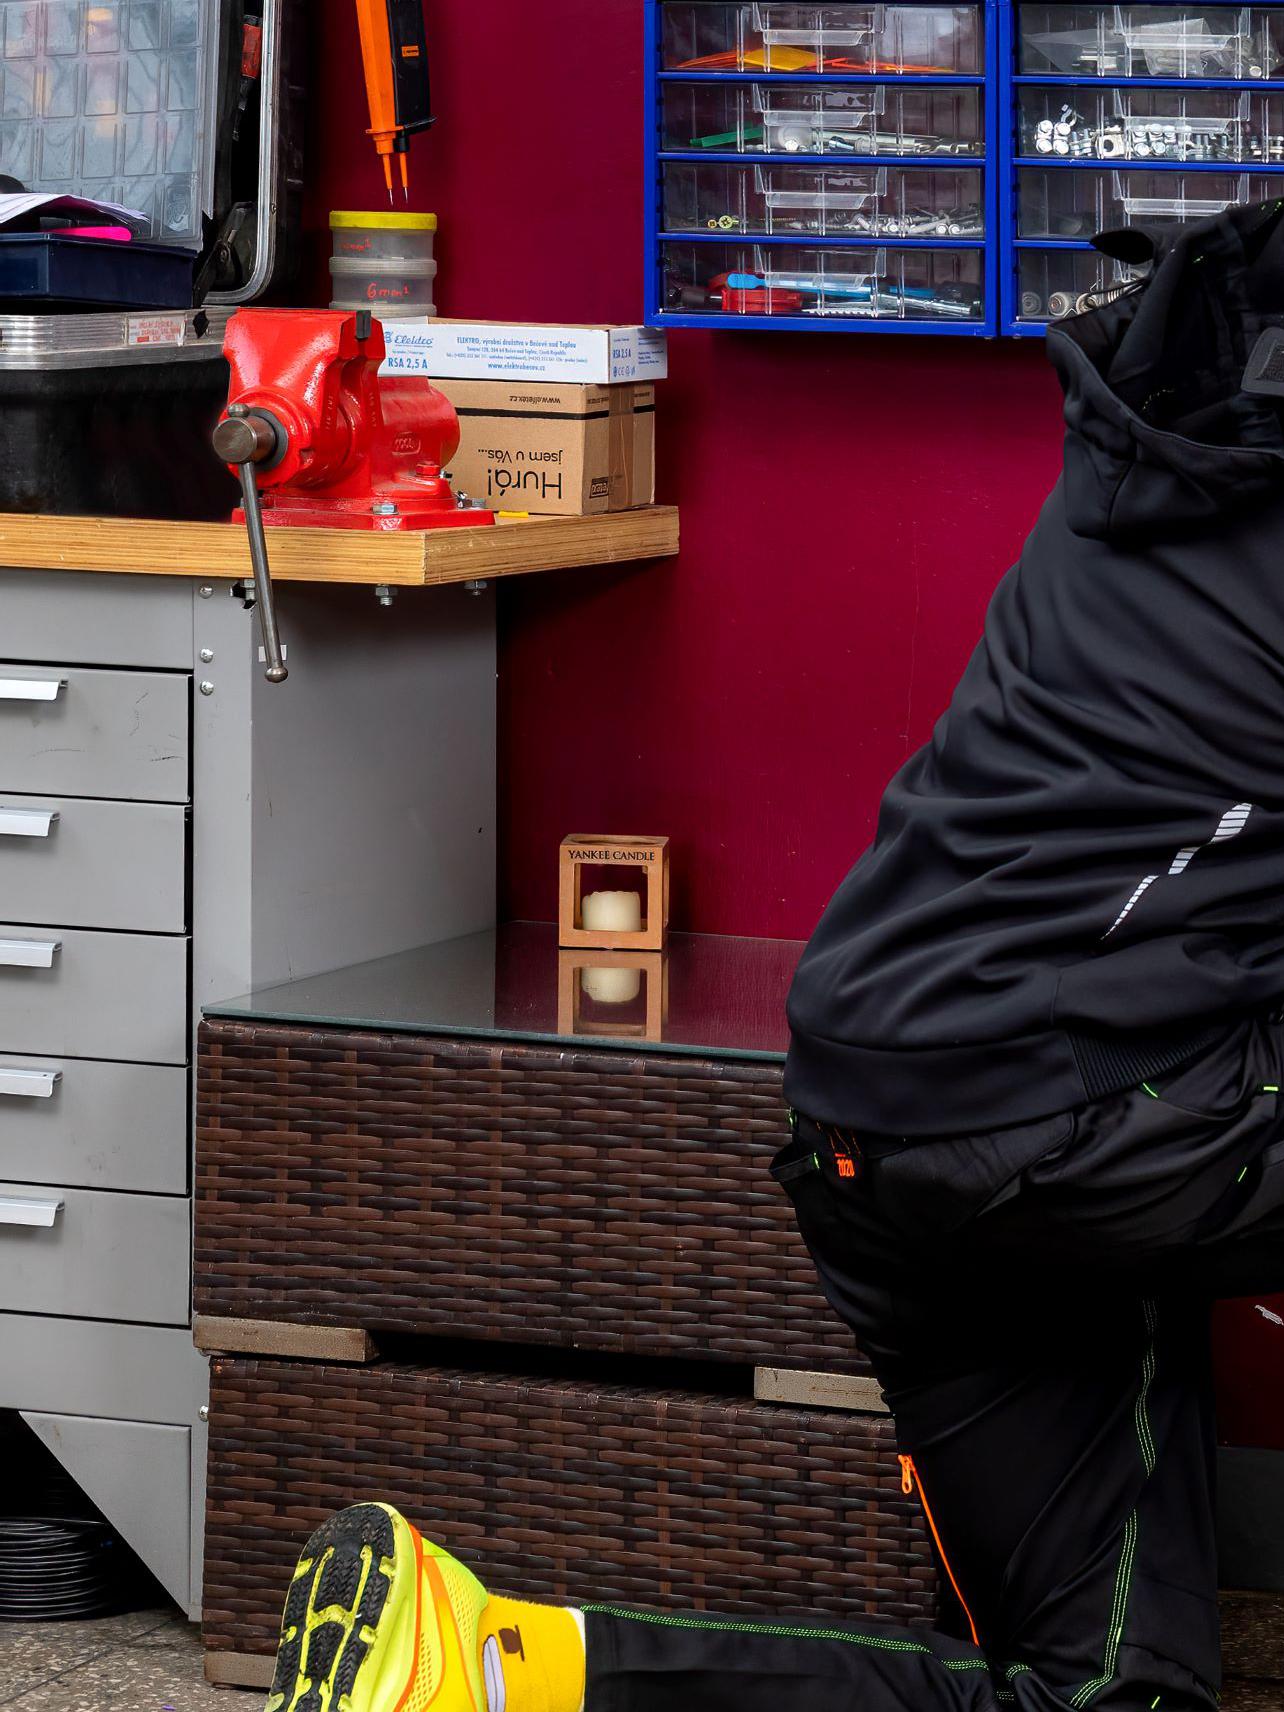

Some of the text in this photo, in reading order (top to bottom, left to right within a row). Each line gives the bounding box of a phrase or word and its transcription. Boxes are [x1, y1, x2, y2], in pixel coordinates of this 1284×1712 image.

[388, 357, 428, 369] RSA 2,5 A
[478, 449, 563, 464] jsem u Vás...
[487, 469, 562, 499] Hurá!
[568, 850, 655, 861] YANKEE CANDLE
